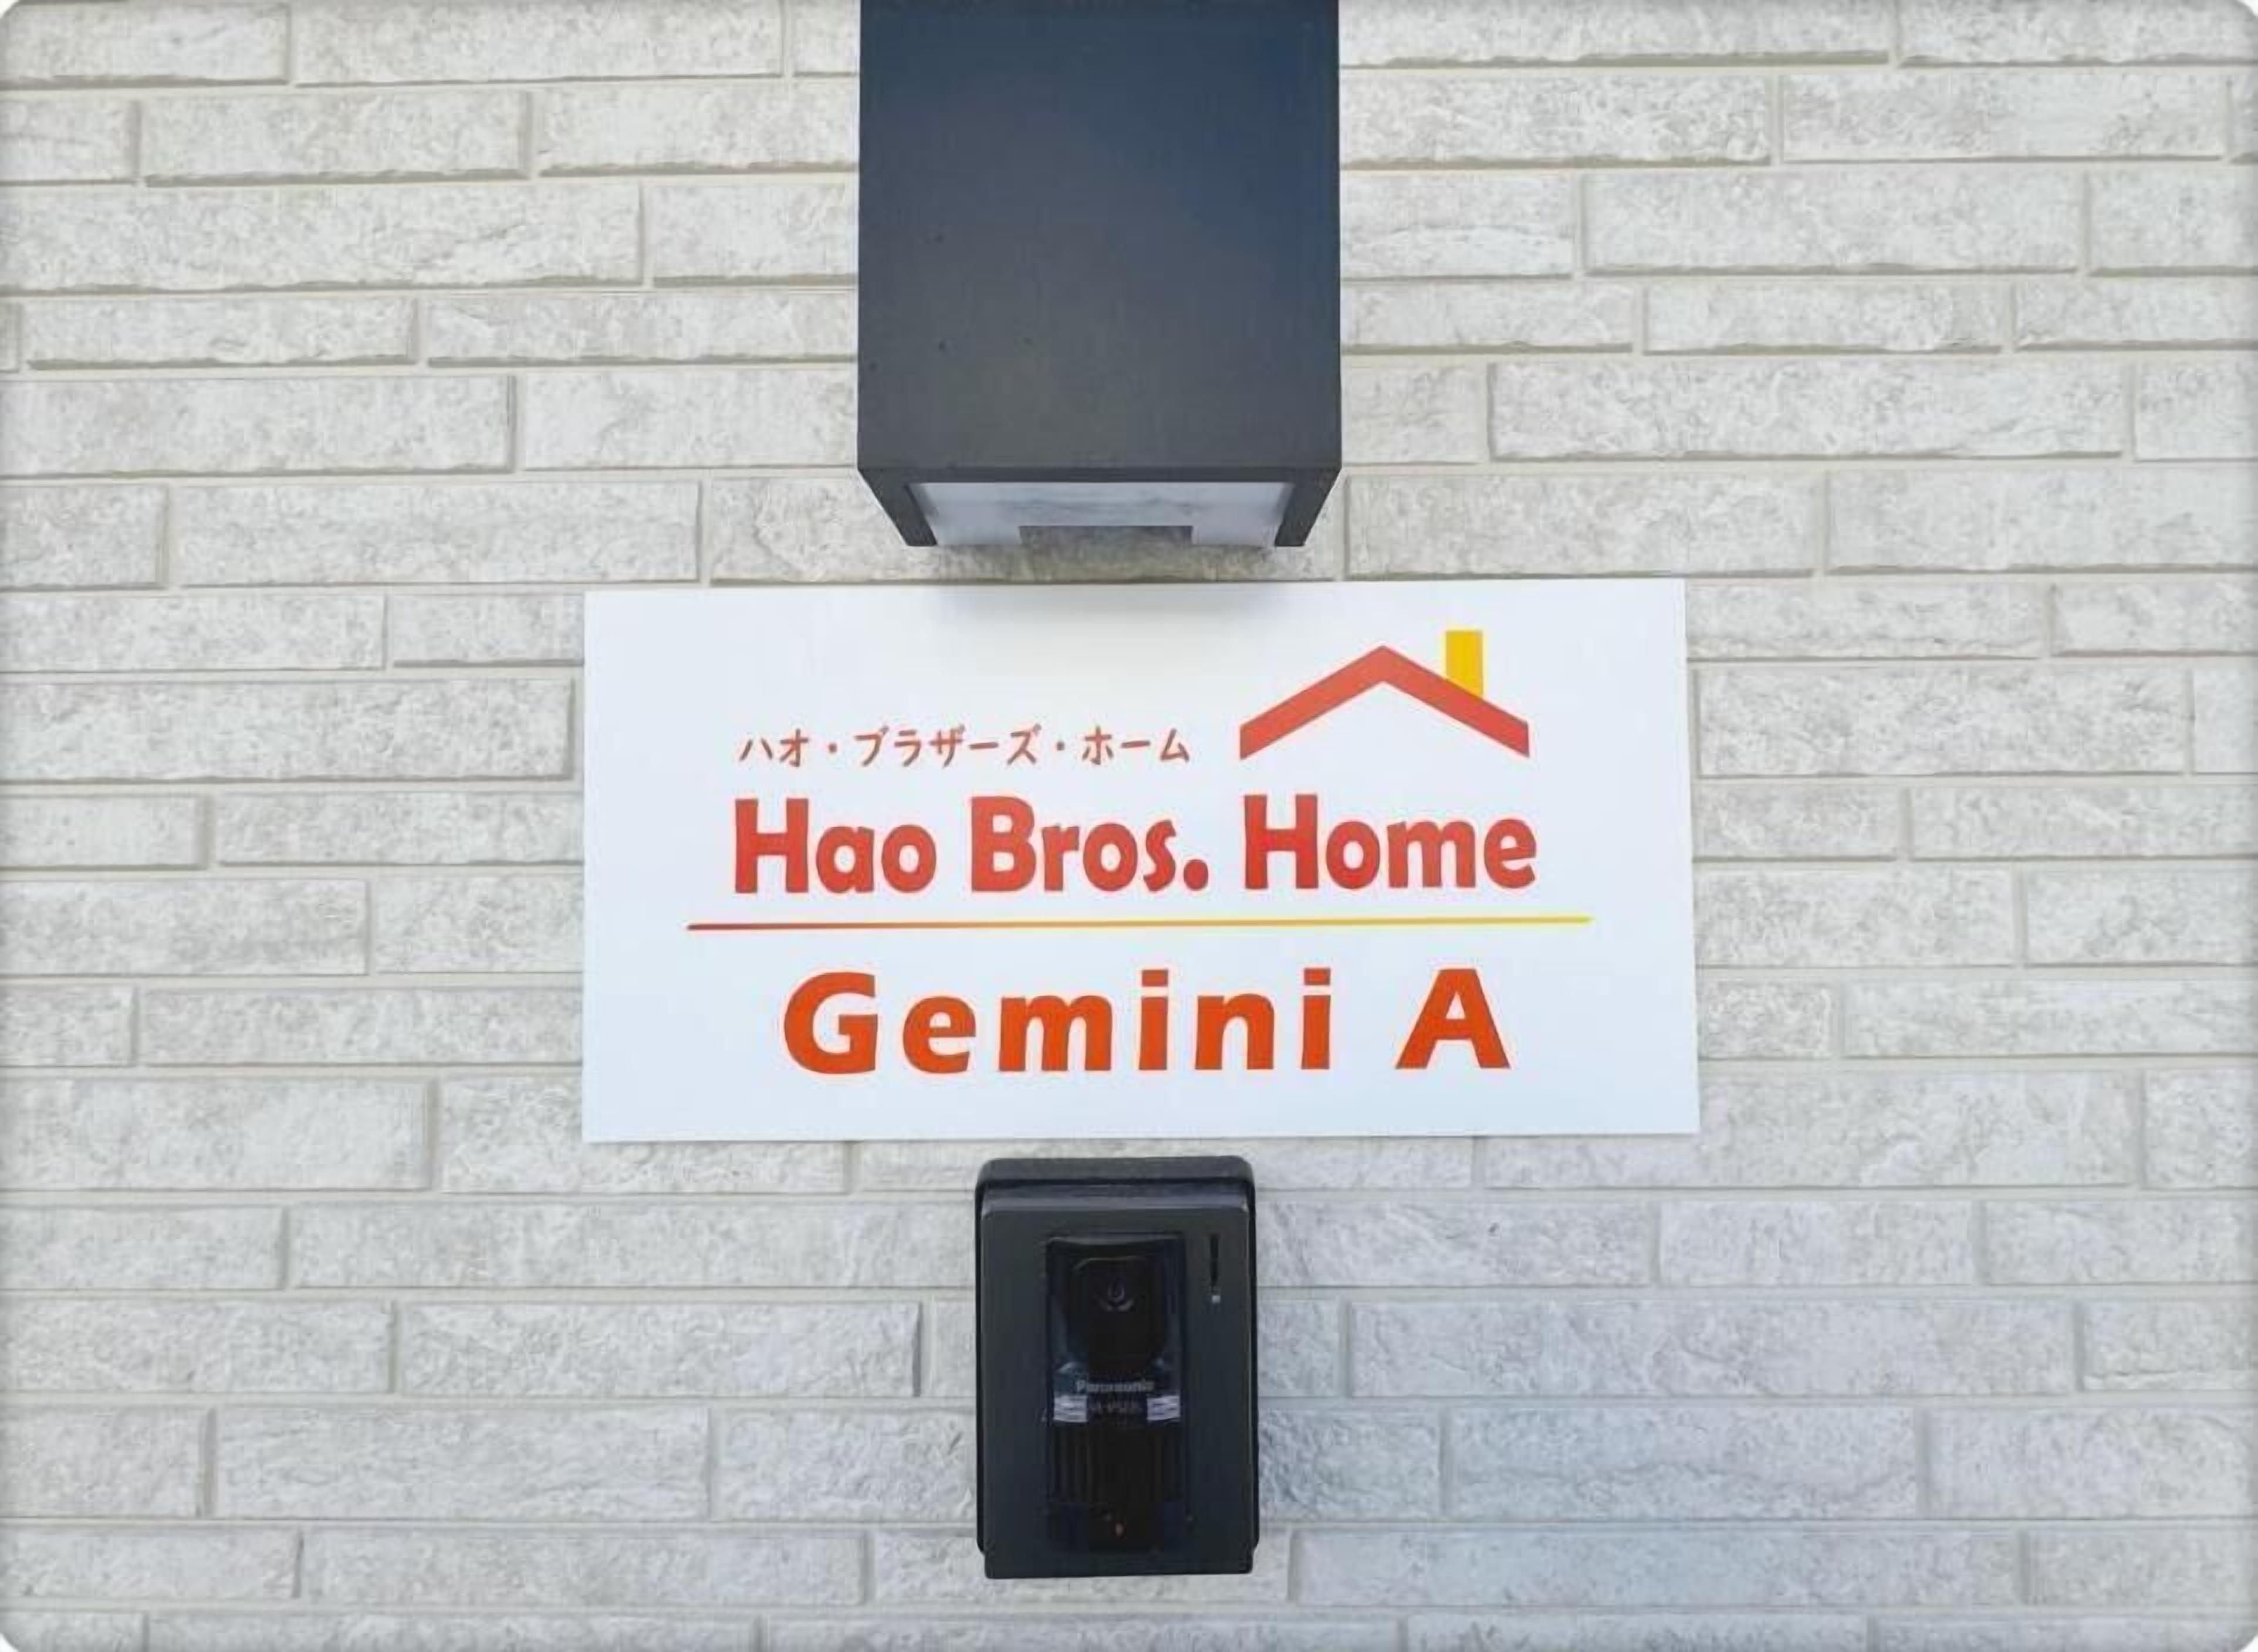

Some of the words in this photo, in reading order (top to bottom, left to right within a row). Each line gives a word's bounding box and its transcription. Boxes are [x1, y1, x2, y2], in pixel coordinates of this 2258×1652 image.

[738, 724, 1191, 768] ハオ・ブラザーズ・ホーム
[733, 798, 937, 895] Hao
[970, 794, 1208, 892] Bros.
[1243, 793, 1537, 891] Home
[782, 967, 1331, 1076] Gemini
[1395, 967, 1512, 1071] A
